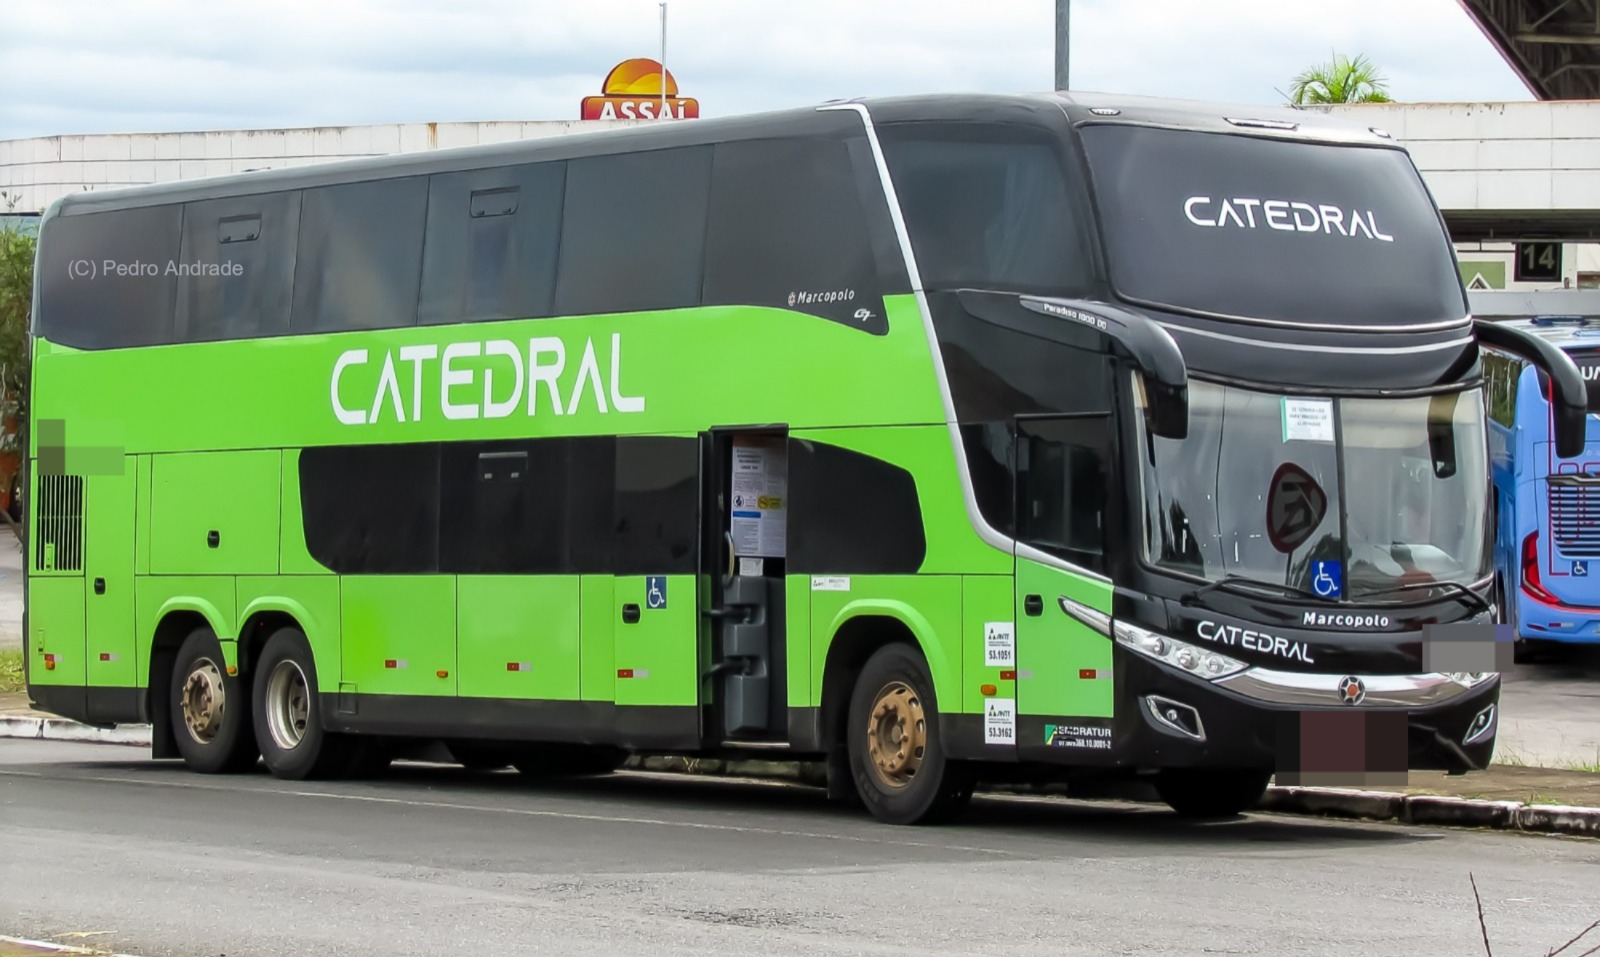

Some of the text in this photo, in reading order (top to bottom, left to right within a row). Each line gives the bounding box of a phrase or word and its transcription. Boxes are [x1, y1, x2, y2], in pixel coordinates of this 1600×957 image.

[1184, 196, 1395, 242] CATEDRAL
[1523, 244, 1555, 270] 14
[797, 288, 855, 304] Marcopolo
[1044, 303, 1077, 319] Paradiso
[331, 333, 645, 425] CATEDRAL
[1303, 611, 1389, 628] Marcopolo
[1197, 620, 1314, 664] CATEDRAL
[988, 650, 1011, 660] 53.1051
[988, 727, 1012, 738] 53.3162
